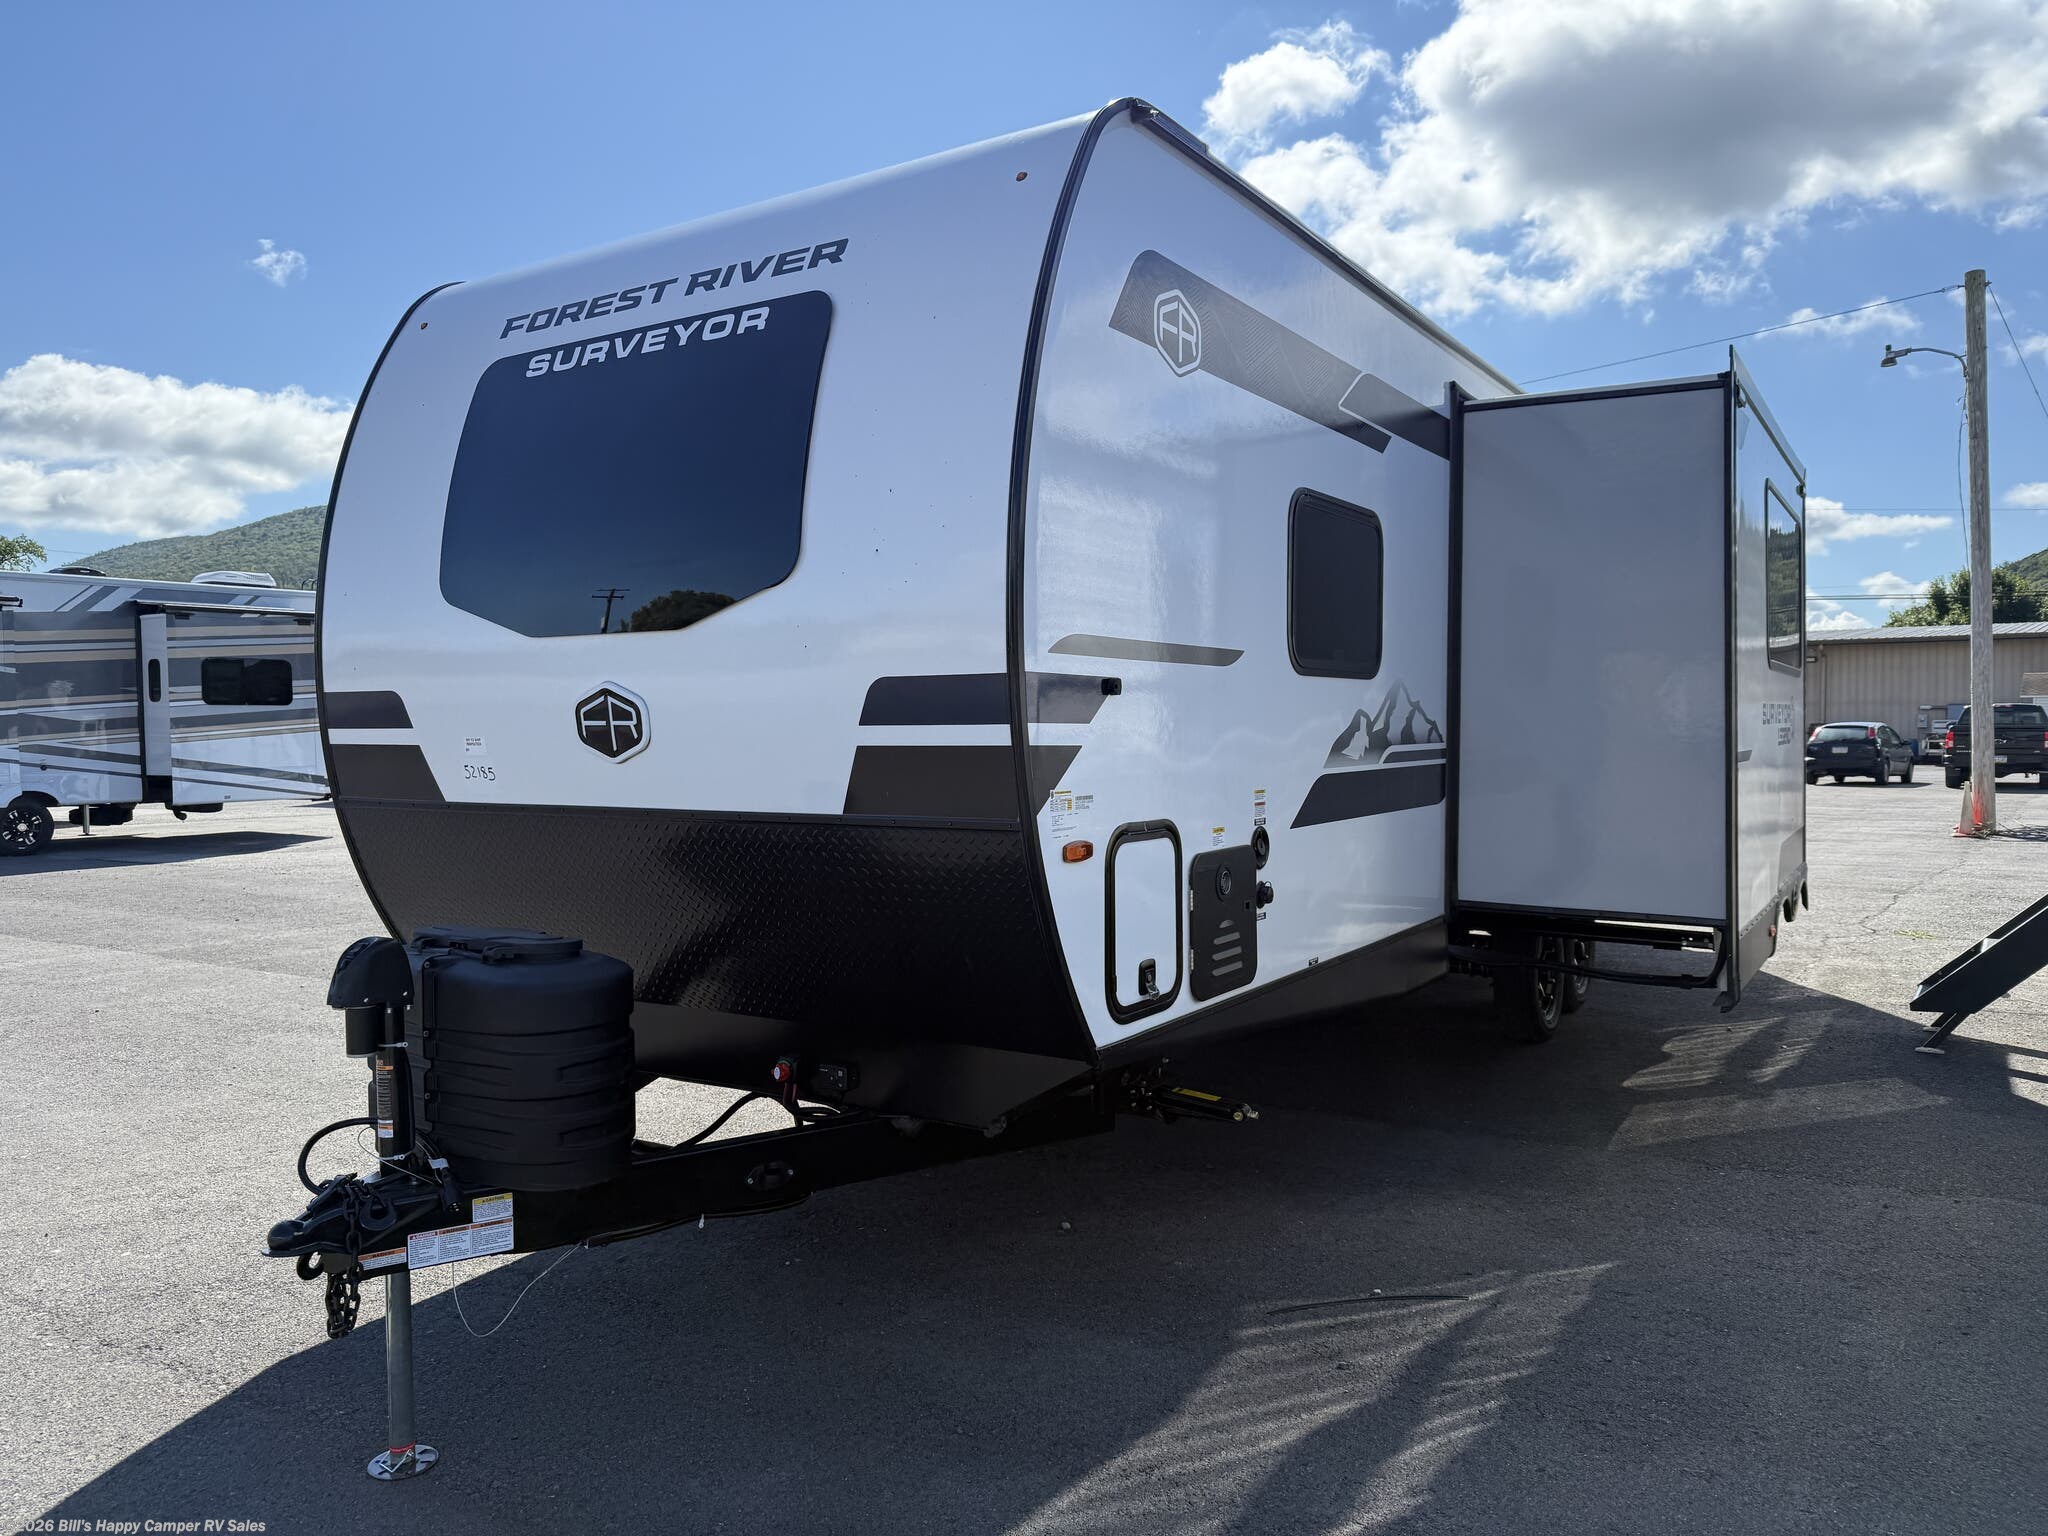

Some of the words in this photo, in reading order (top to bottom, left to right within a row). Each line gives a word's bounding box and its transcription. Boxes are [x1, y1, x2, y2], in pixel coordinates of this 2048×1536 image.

[499, 278, 679, 340] FOREST
[684, 238, 849, 296] RIVER
[525, 306, 770, 378] SURVEYOR
[463, 764, 496, 781] 52185
